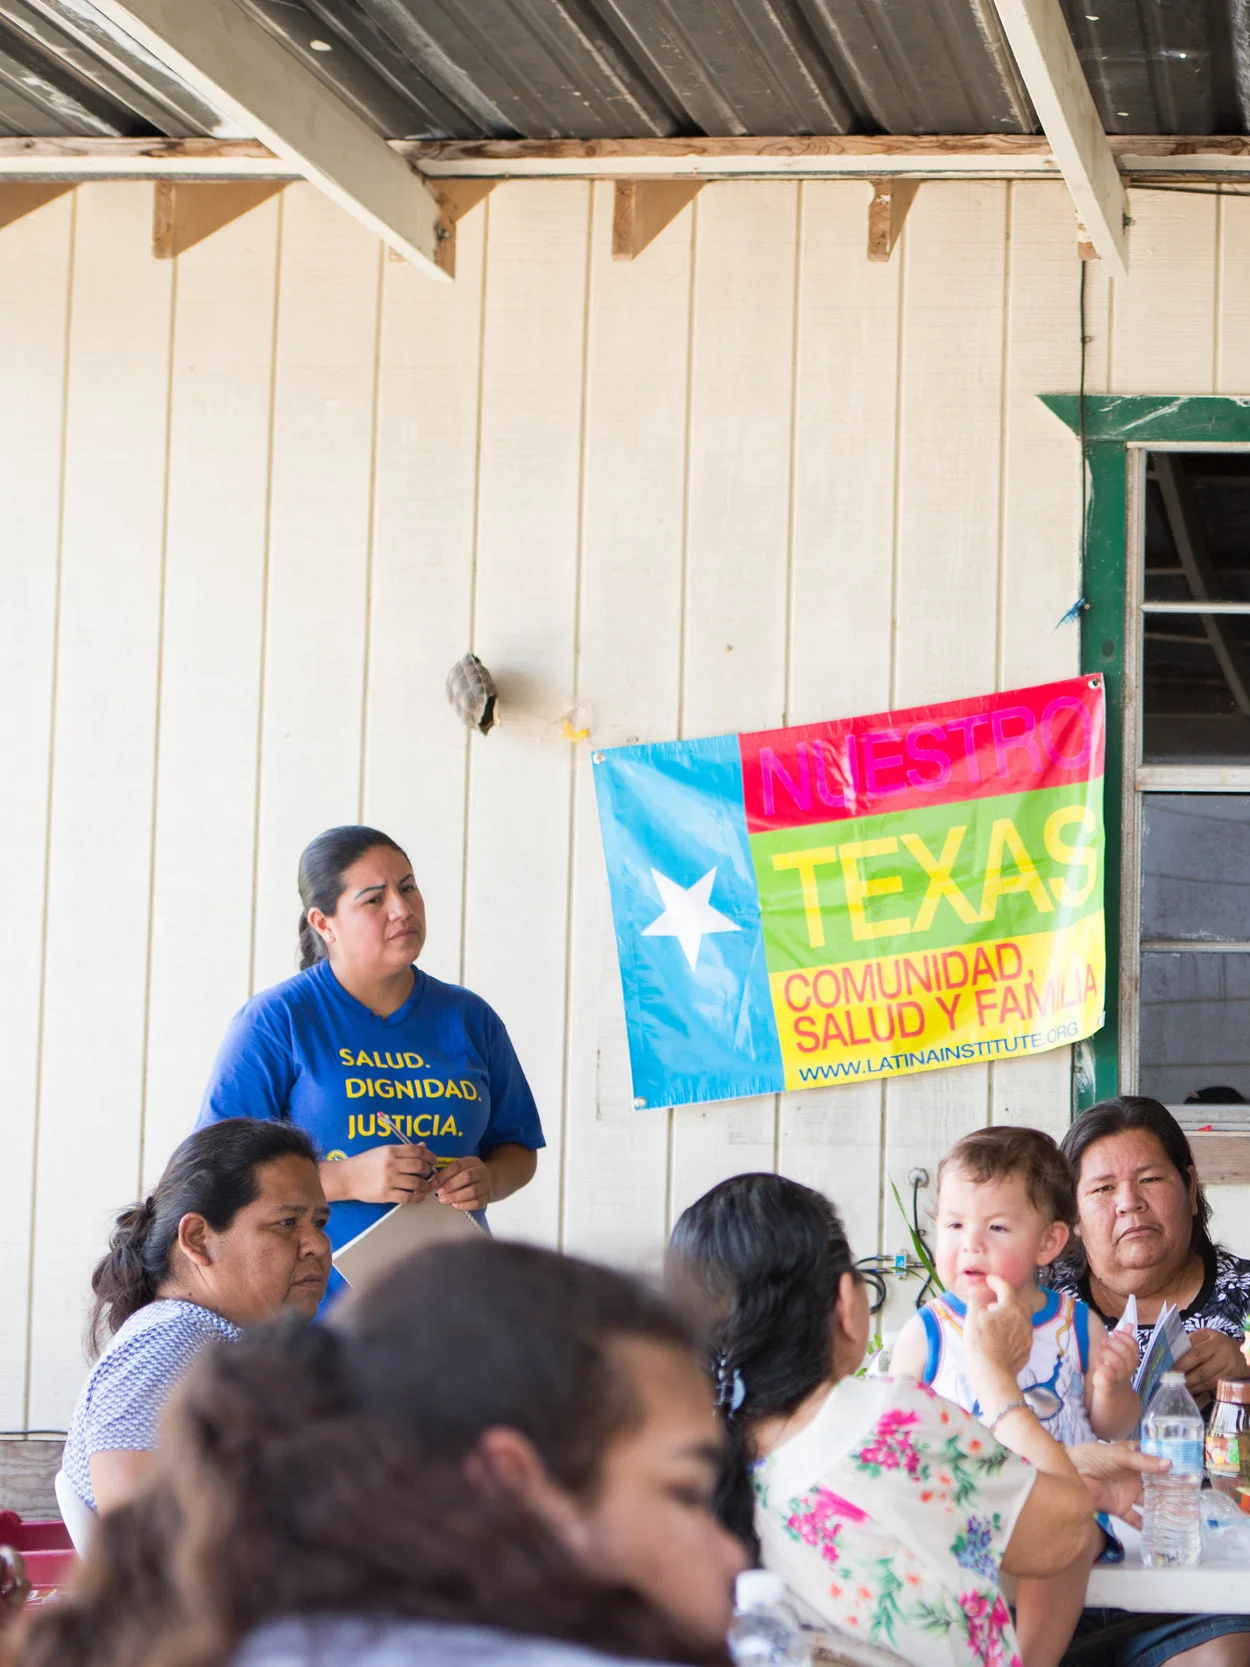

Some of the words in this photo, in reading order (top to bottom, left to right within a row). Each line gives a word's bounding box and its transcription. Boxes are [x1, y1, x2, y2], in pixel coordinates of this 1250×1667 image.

[759, 696, 1093, 815] NUESTRO
[772, 805, 1097, 948] TEXAS
[784, 942, 1034, 1013] COMUNIDAD,
[793, 1001, 925, 1054] SALUD
[935, 993, 971, 1032] Y
[975, 964, 1098, 1027] FAMILIA
[339, 1048, 431, 1069] SALUD.
[799, 1022, 1079, 1082] WWW.LATINAINSTITUTE.ORG
[345, 1078, 482, 1102] DIGNIDAD.
[348, 1113, 463, 1140] JUSTICIA.
